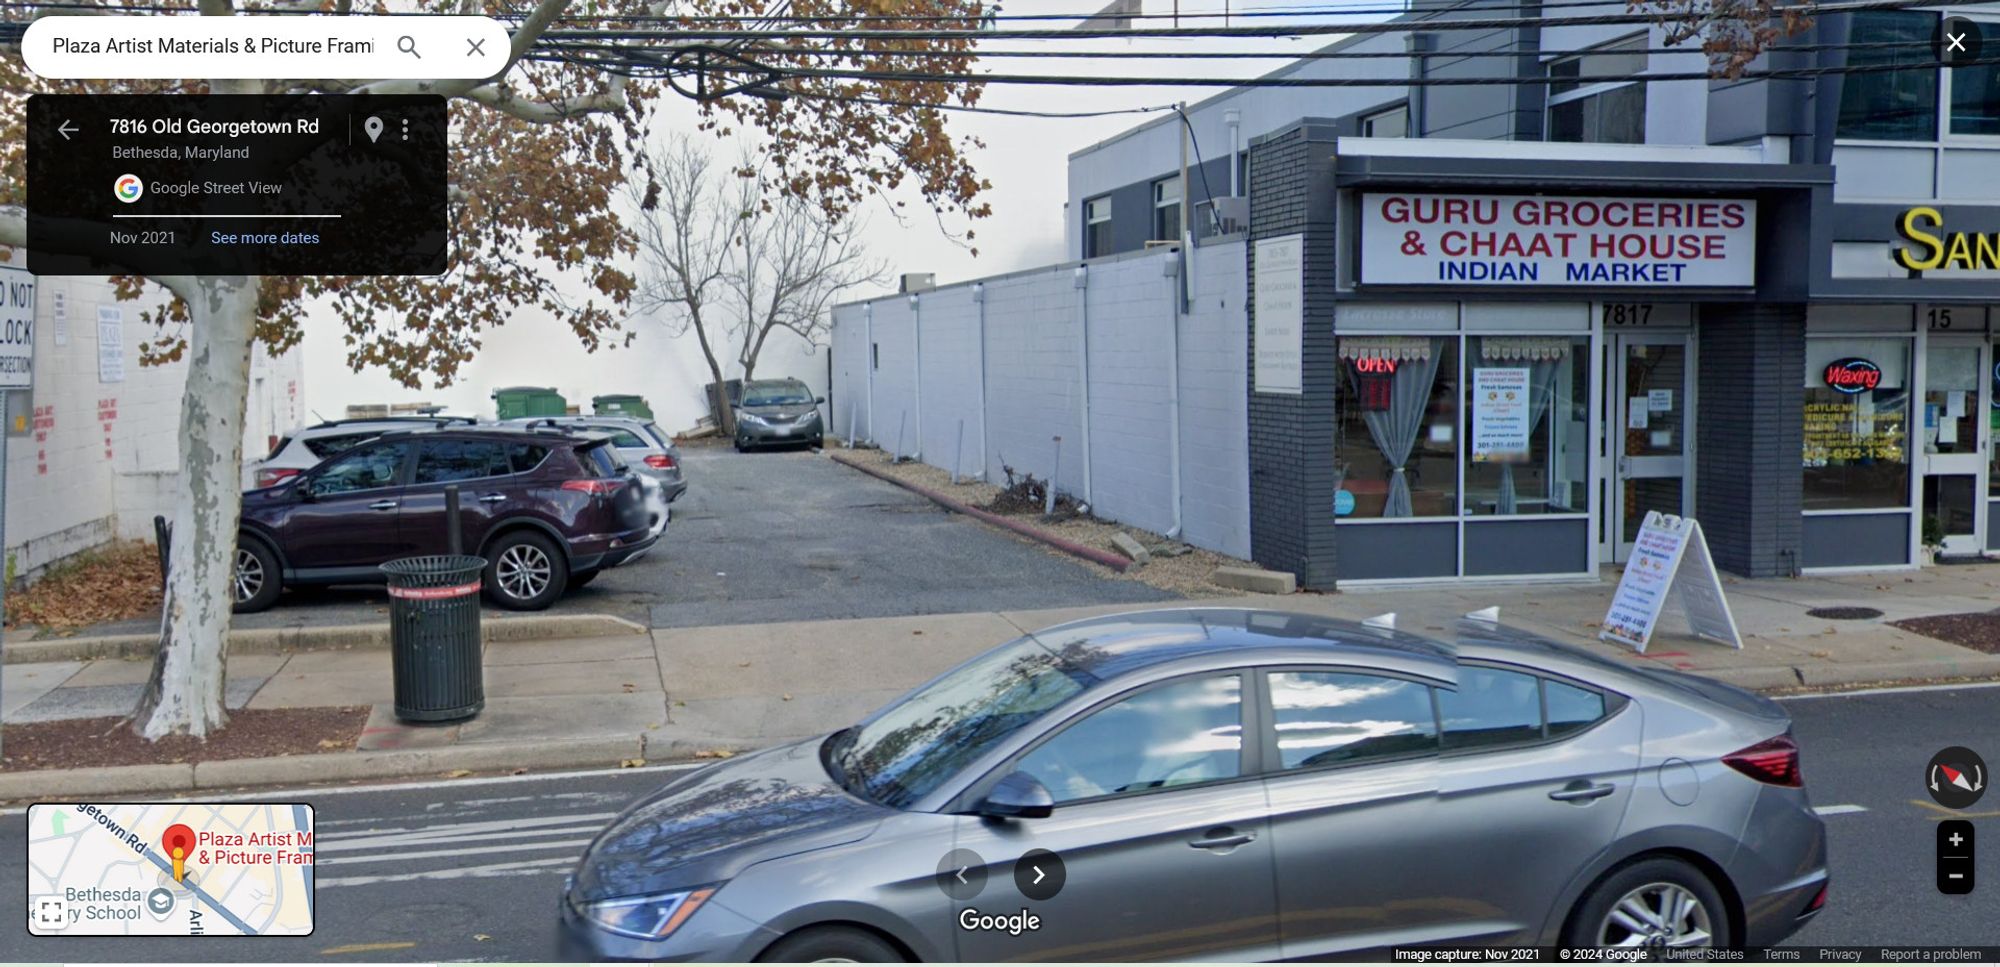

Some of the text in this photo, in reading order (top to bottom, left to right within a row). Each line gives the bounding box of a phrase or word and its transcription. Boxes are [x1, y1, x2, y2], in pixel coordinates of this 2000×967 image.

[1380, 197, 1746, 229] GURU GROCERIES
[1400, 230, 1727, 260] & CHAAT HOUSE
[1438, 261, 1687, 283] INDIAN MARKET
[10, 281, 34, 309] NOT
[1602, 304, 1653, 325] 7817
[1928, 309, 1951, 328] 15
[1357, 356, 1396, 373] OPEN
[1827, 366, 1880, 388] Waxing
